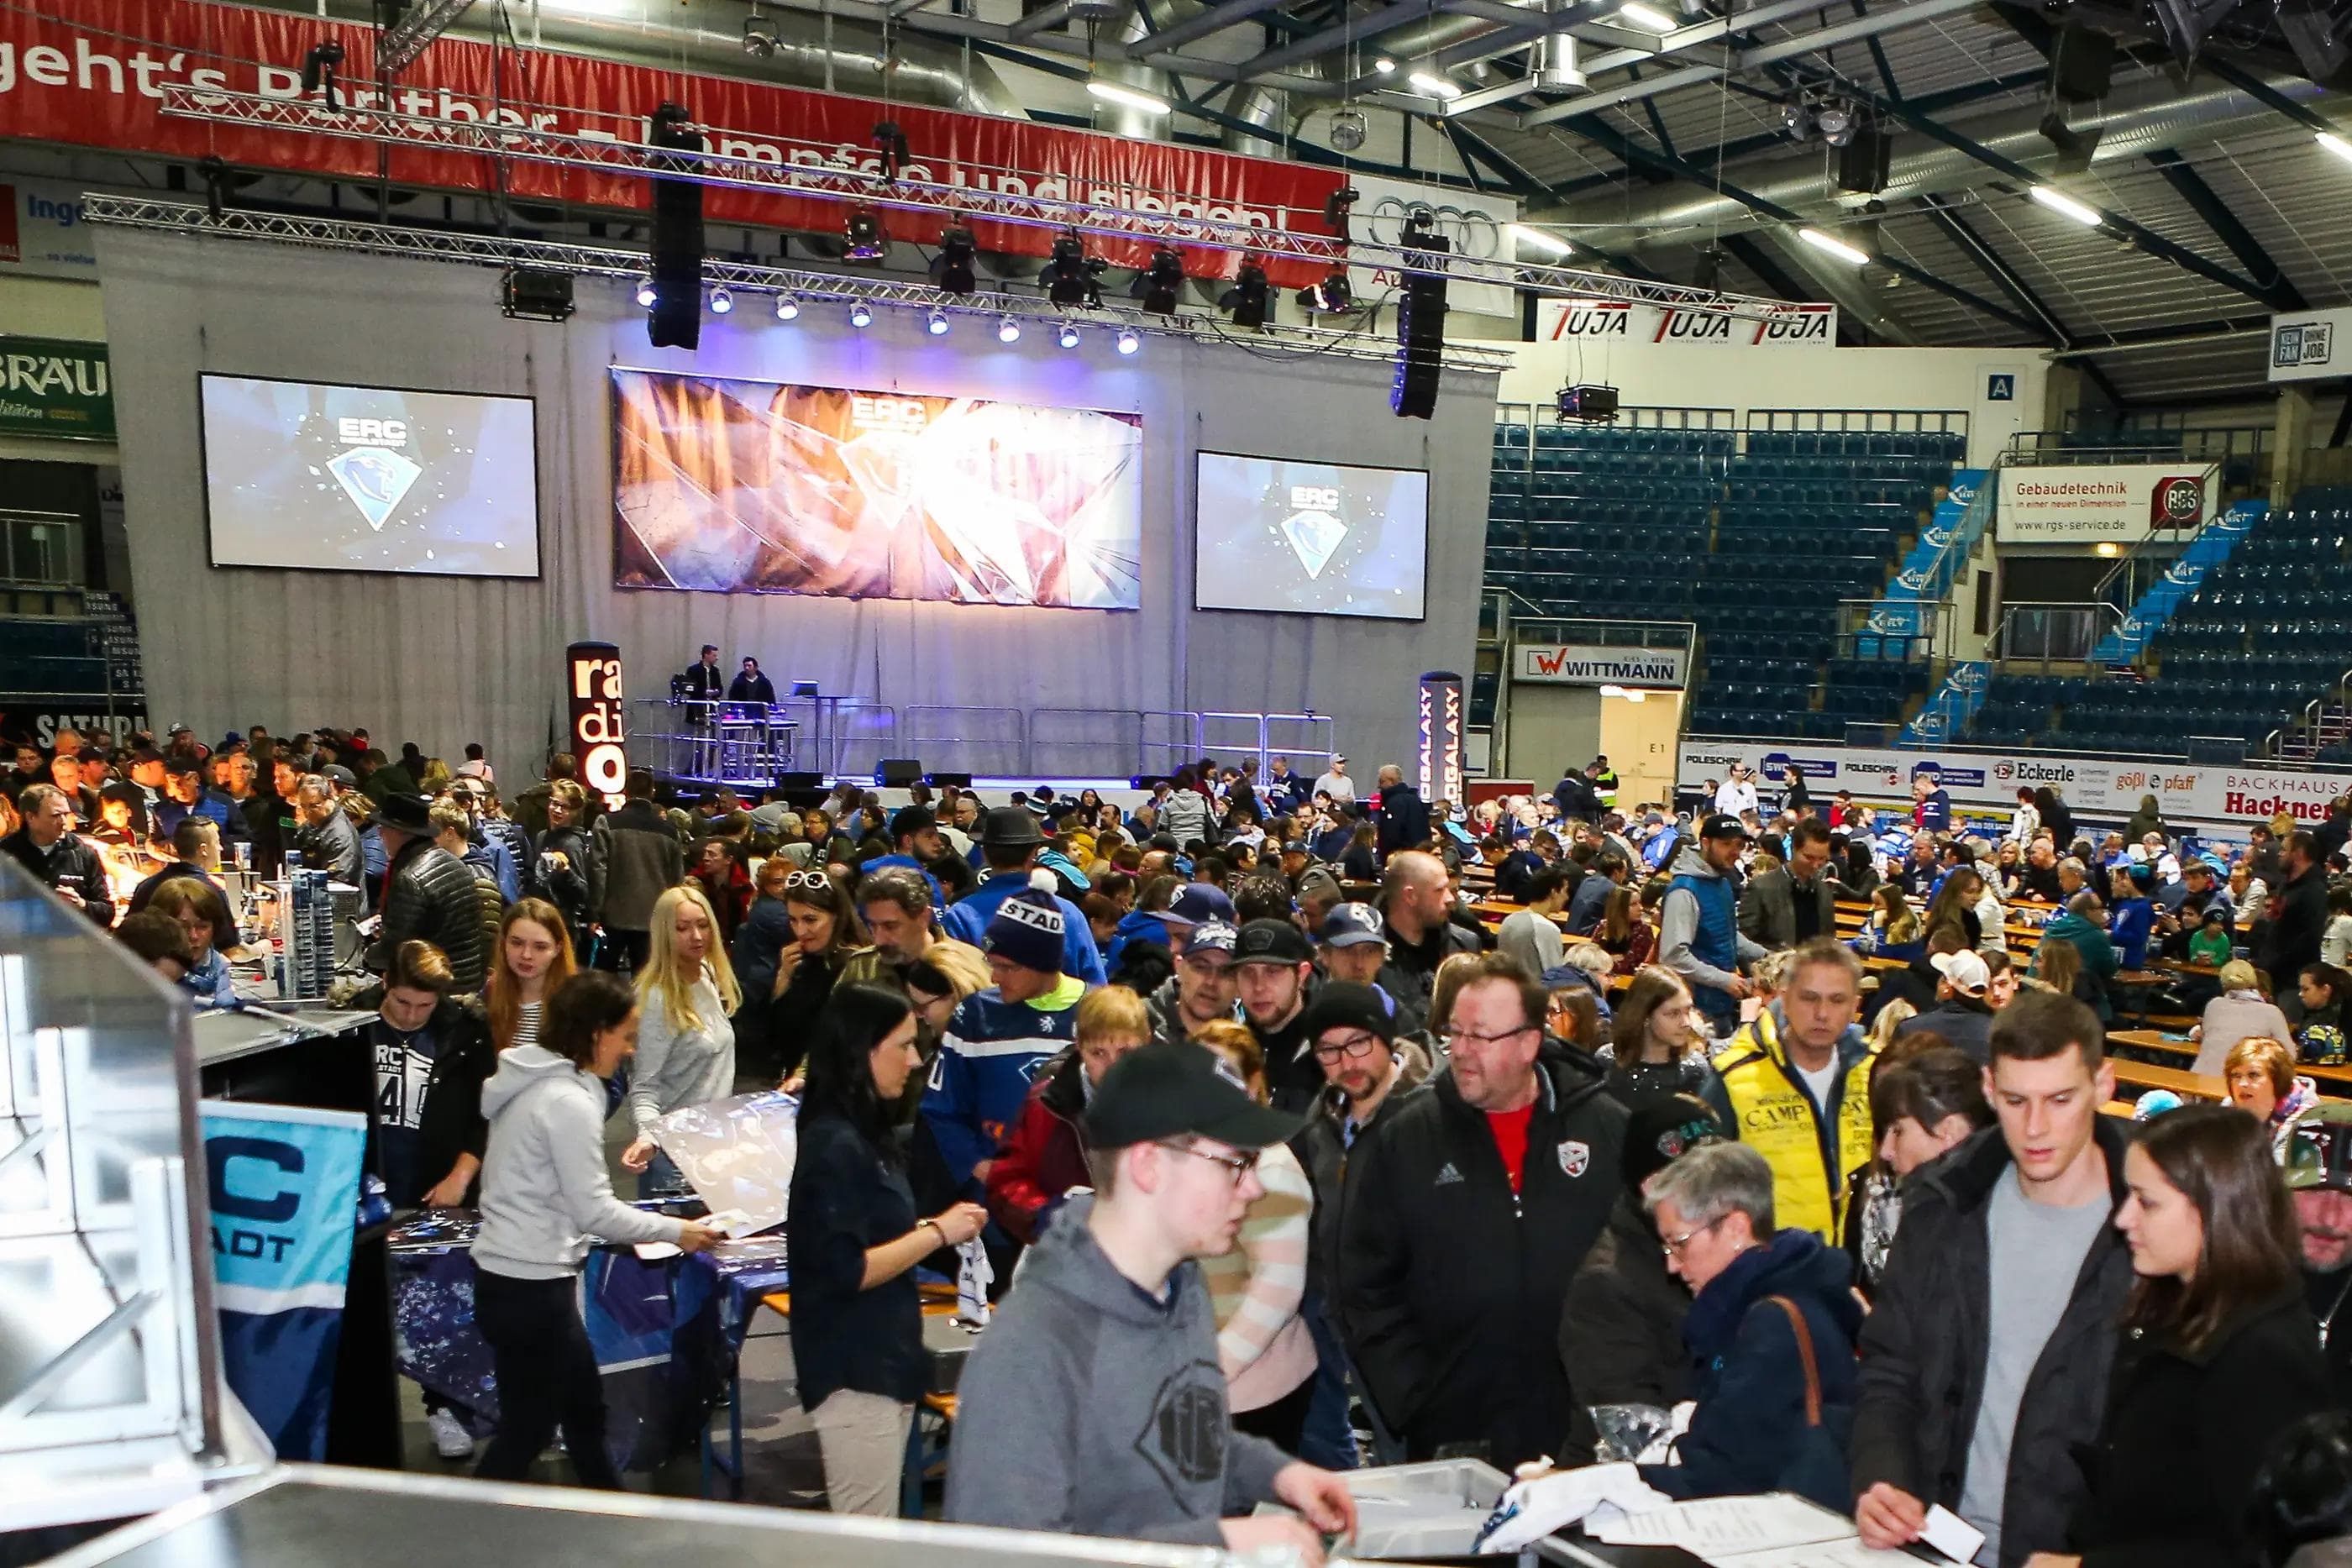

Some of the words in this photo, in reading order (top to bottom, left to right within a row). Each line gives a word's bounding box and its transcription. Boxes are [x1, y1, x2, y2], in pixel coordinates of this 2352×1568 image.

[955, 172, 1067, 213] und
[1091, 183, 1270, 244] siegen!
[0, 354, 108, 396] RÄU
[1992, 378, 2009, 396] A
[339, 417, 407, 440] ERC
[1290, 486, 1339, 505] ERC
[2017, 481, 2127, 496] Gebäudetechnik
[2014, 520, 2126, 532] www.rgs-service.de
[1566, 661, 1674, 680] WITTMANN
[2017, 763, 2075, 782] Eckerle
[2164, 774, 2197, 792] pfaff
[2227, 775, 2339, 794] BACKHAUS
[1005, 904, 1060, 931] STAD
